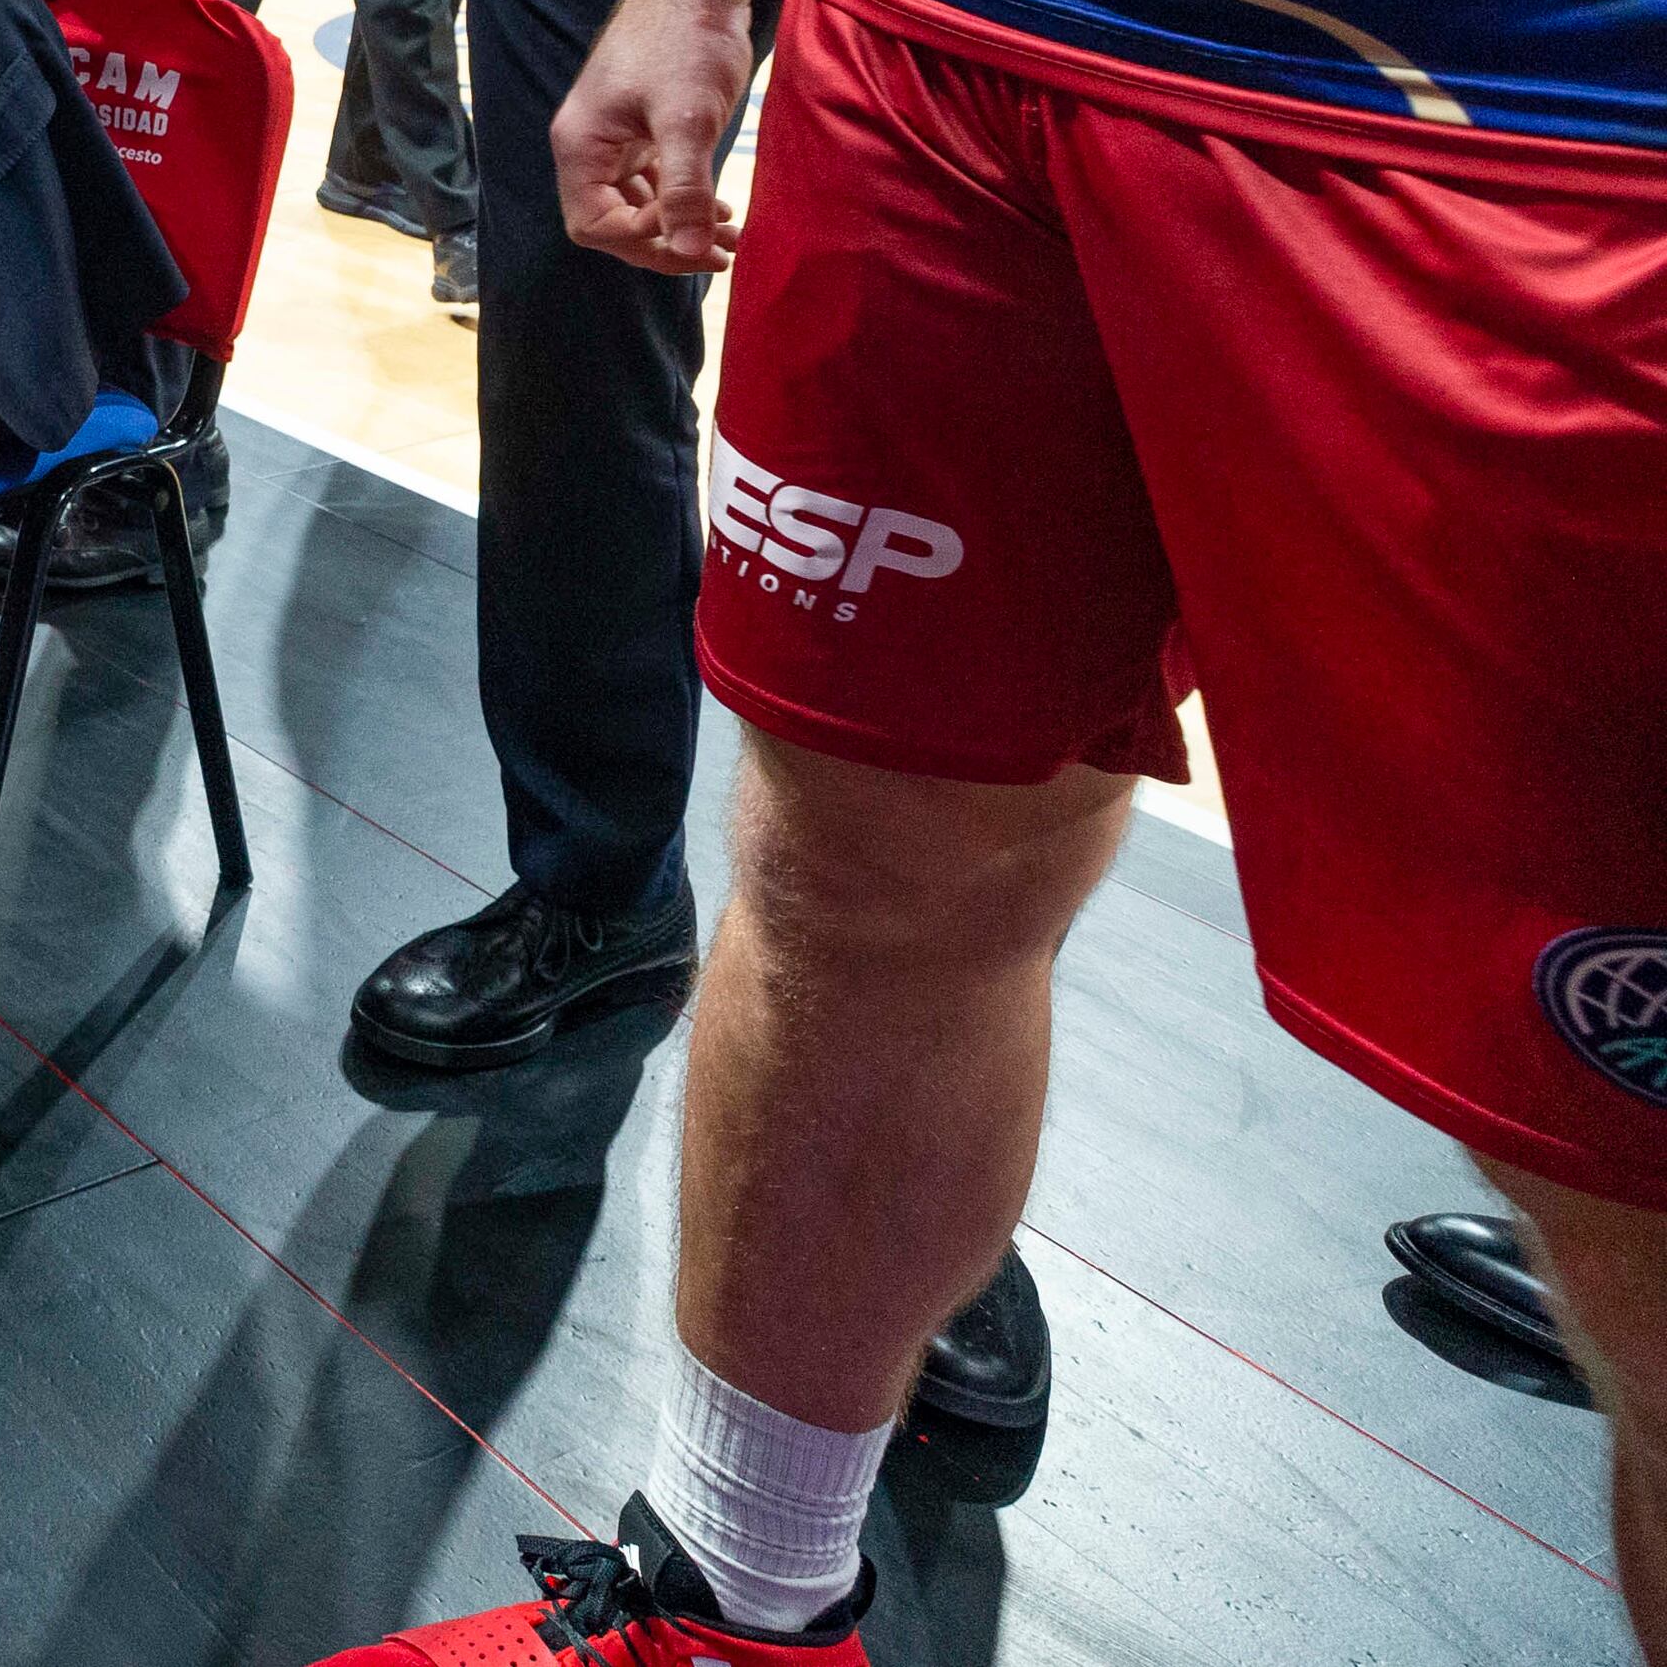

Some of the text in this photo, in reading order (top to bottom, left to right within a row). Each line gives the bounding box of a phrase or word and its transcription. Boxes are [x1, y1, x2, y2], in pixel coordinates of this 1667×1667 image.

[67, 46, 182, 111] CAM
[98, 103, 169, 137] SIDAD
[117, 146, 163, 166] cesto
